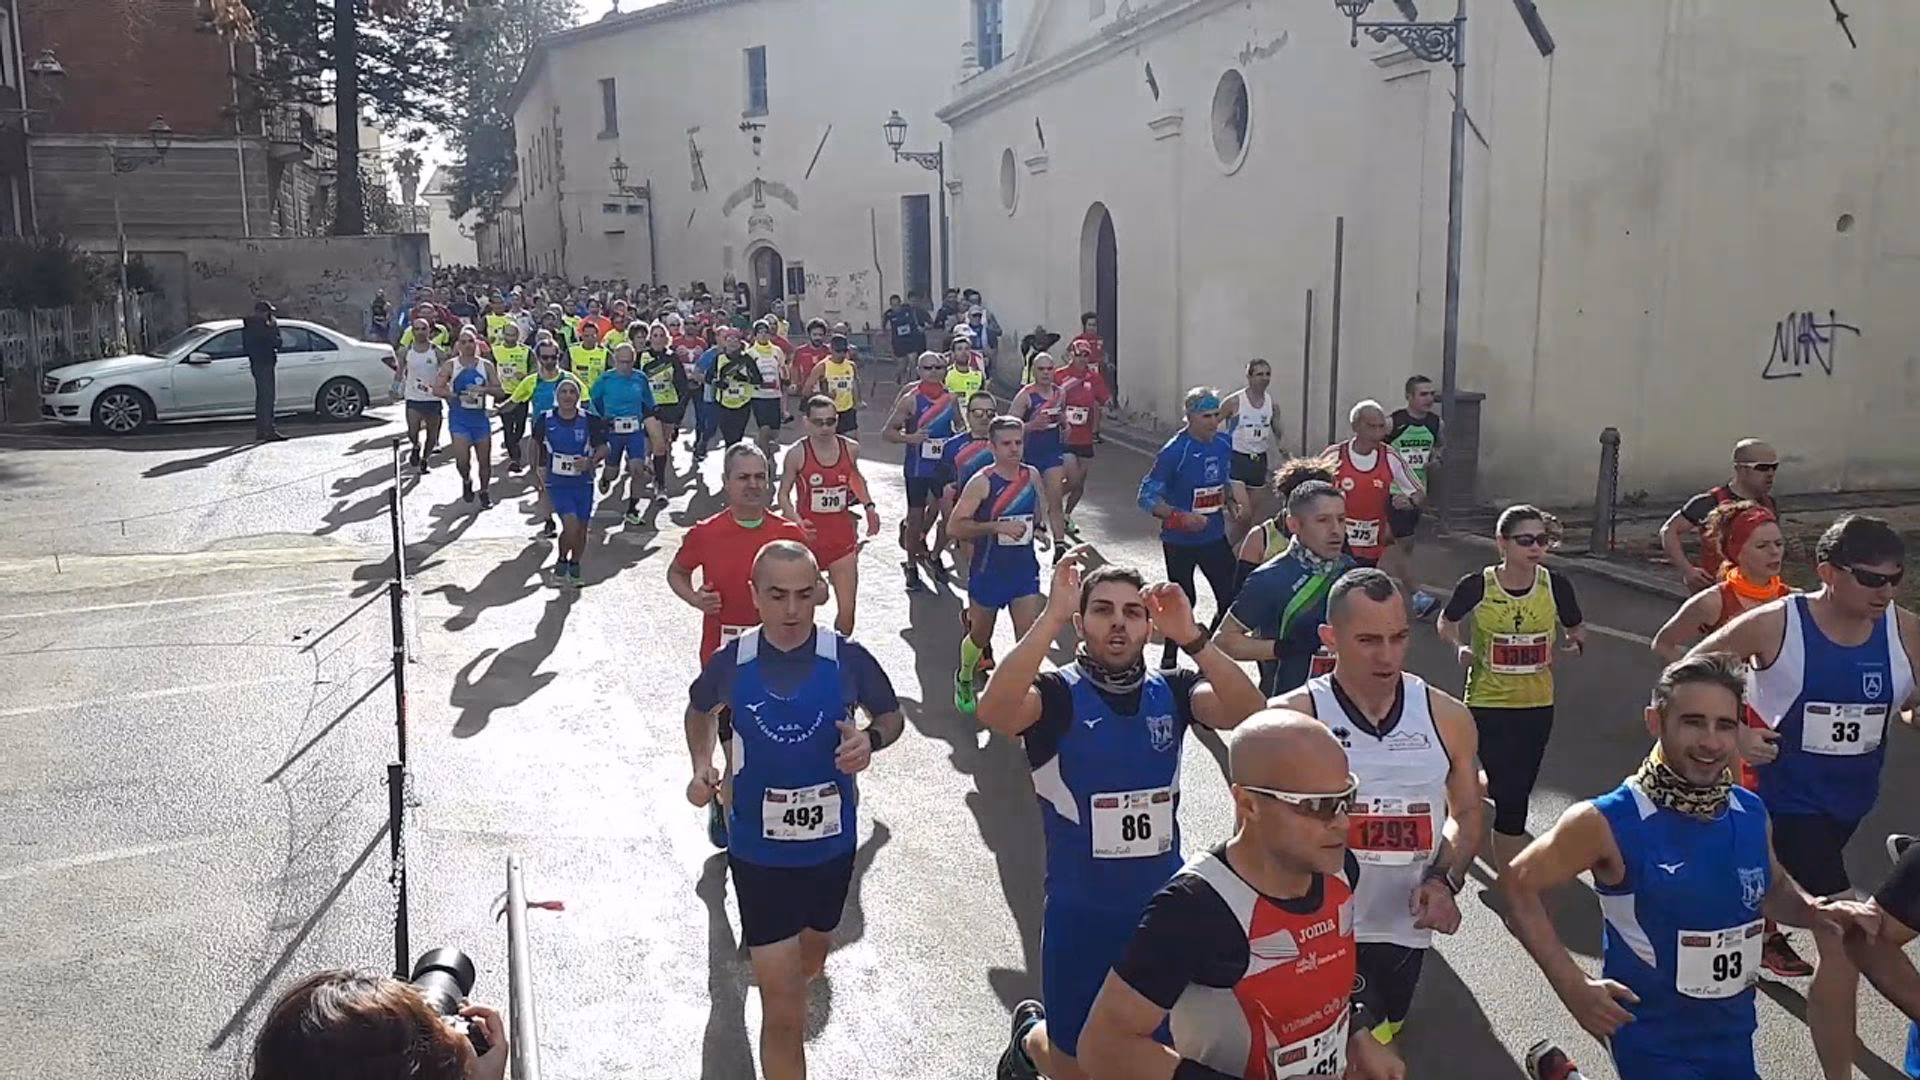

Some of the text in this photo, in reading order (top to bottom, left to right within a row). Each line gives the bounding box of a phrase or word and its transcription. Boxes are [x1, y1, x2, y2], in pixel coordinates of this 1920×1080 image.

[561, 462, 573, 471] 82
[1408, 454, 1424, 464] 255
[821, 496, 840, 507] 370
[1351, 529, 1371, 540] 375
[1832, 721, 1860, 743] 33
[782, 804, 824, 828] 493
[1121, 812, 1151, 841] 86
[1357, 819, 1419, 848] 1293
[1712, 951, 1742, 982] 93
